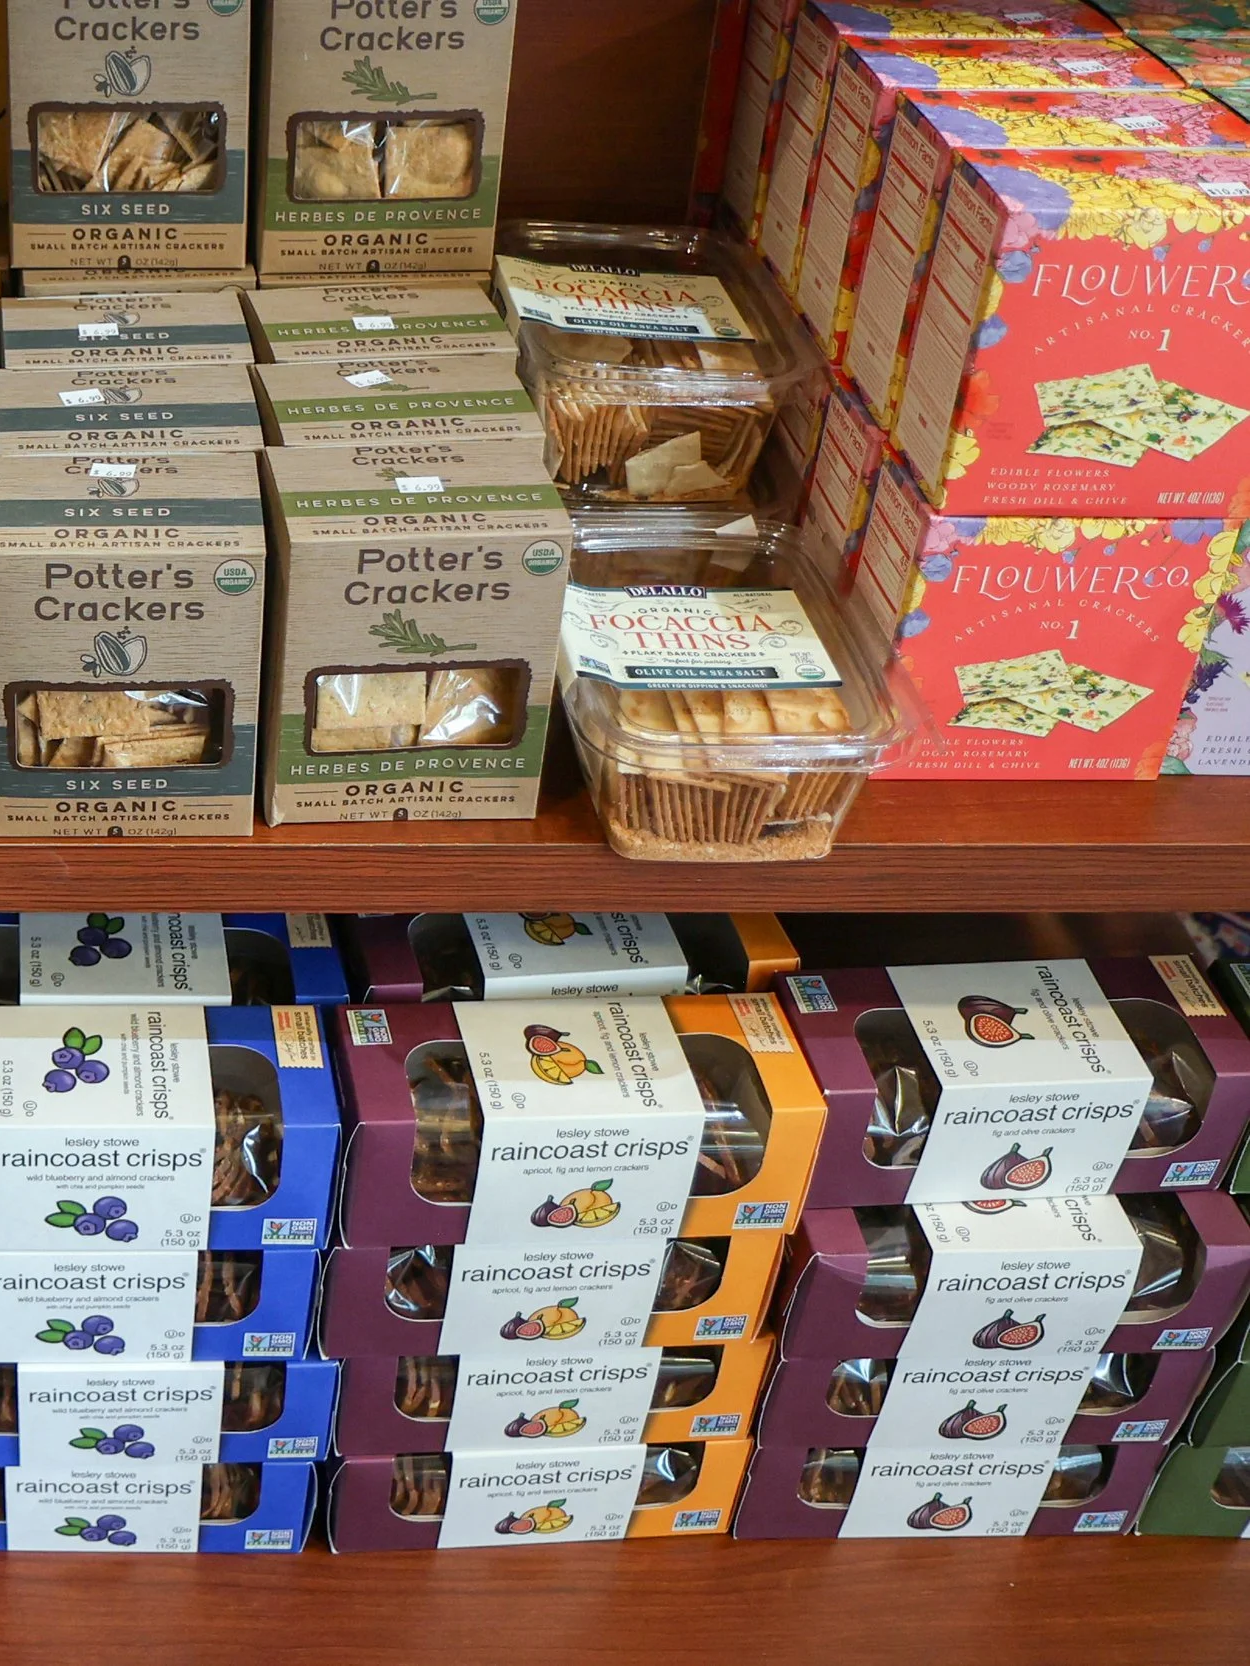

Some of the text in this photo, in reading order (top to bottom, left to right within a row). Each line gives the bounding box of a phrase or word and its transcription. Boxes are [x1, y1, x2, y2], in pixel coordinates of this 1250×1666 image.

[330, 0, 457, 20] Potter's
[54, 16, 200, 41] Crackers
[320, 26, 465, 51] Crackers
[81, 203, 170, 215] SIX SEED
[275, 208, 481, 223] HERBES DE PROVENCE
[534, 279, 698, 304] FOCACCIA
[565, 294, 675, 313] THINS
[990, 467, 1111, 478] EDIBLE FLOWERS
[415, 483, 442, 491] 6.99
[986, 481, 1116, 492] WOODY ROSEMARY
[983, 495, 1128, 506] FRESH DILL & CHIVE
[1157, 492, 1172, 504] NET
[1187, 491, 1201, 504] 4OZ
[1203, 491, 1225, 504] (113G)
[357, 546, 502, 575] Potter's
[45, 562, 193, 590] Potter's
[223, 567, 247, 577] USDA
[345, 579, 510, 605] Crackers
[628, 586, 703, 598] DELALLO
[34, 596, 205, 622] Crackers
[639, 607, 712, 616] ORGANIC
[590, 614, 776, 632] FOCACCIA
[954, 600, 1160, 644] ARTISANAL CRACKERS
[1065, 619, 1081, 640] 1
[623, 631, 751, 651] THINS
[634, 668, 766, 677] OLIVE OIL & SEA SALT
[291, 757, 526, 775] HERBES DE PROVENCE
[66, 779, 168, 790] SIX SEED
[346, 781, 464, 797] ORGANIC
[56, 800, 177, 813] ORGANIC
[7, 814, 48, 822] SMALL
[162, 813, 229, 821] CRACKERS
[53, 827, 77, 836] NET
[83, 827, 101, 836] WT
[128, 827, 143, 836] OZ
[146, 827, 177, 837] (142g)
[147, 1010, 168, 1074] raincoast
[1009, 1092, 1080, 1104] lesley stowe
[943, 1101, 1134, 1125] raincoast crisps
[556, 1127, 630, 1140] lesley stowe
[65, 1137, 140, 1147] lesley stowe
[491, 1139, 689, 1162] raincoast crisps
[1, 1148, 202, 1171] raincoast crisps
[555, 1166, 567, 1175] fig
[569, 1165, 584, 1174] and
[586, 1164, 612, 1173] lemon
[614, 1163, 649, 1172] crackers
[26, 1174, 175, 1183] wild blueberry and almond crackers
[164, 1229, 183, 1237] 5.3
[160, 1238, 200, 1248] (150 g)
[461, 1261, 651, 1283] raincoast crisps
[113, 1274, 186, 1293] crisps
[937, 1272, 1126, 1293] raincoast crisps
